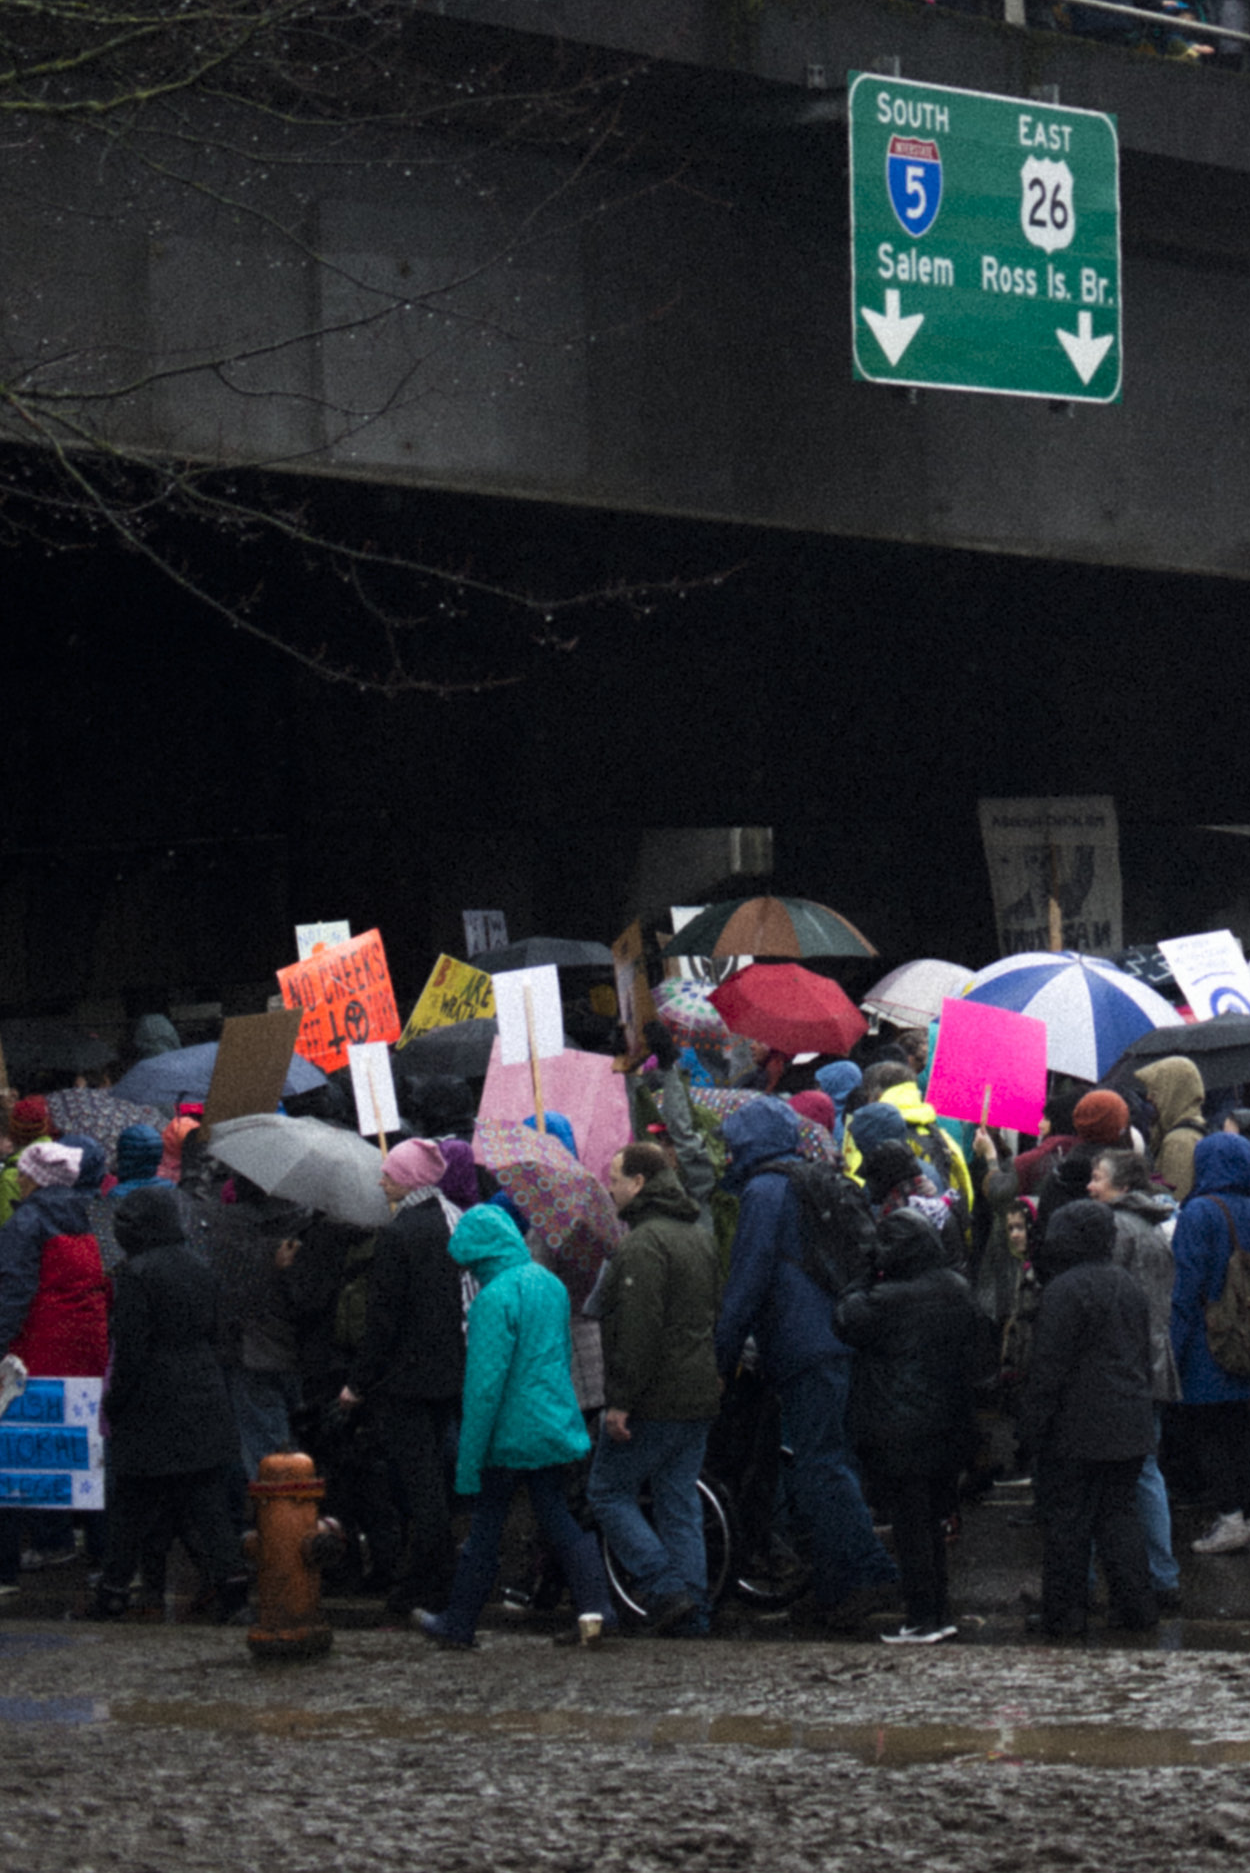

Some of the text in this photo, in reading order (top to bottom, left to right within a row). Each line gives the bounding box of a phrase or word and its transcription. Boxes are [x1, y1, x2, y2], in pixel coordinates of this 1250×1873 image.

[877, 91, 949, 133] SOUTH
[1018, 114, 1072, 152] EAST
[904, 165, 927, 220] 5
[1028, 177, 1069, 231] 26
[877, 242, 954, 287] Salem
[981, 255, 1114, 306] Ross Is. Br.
[287, 972, 316, 1012] NO
